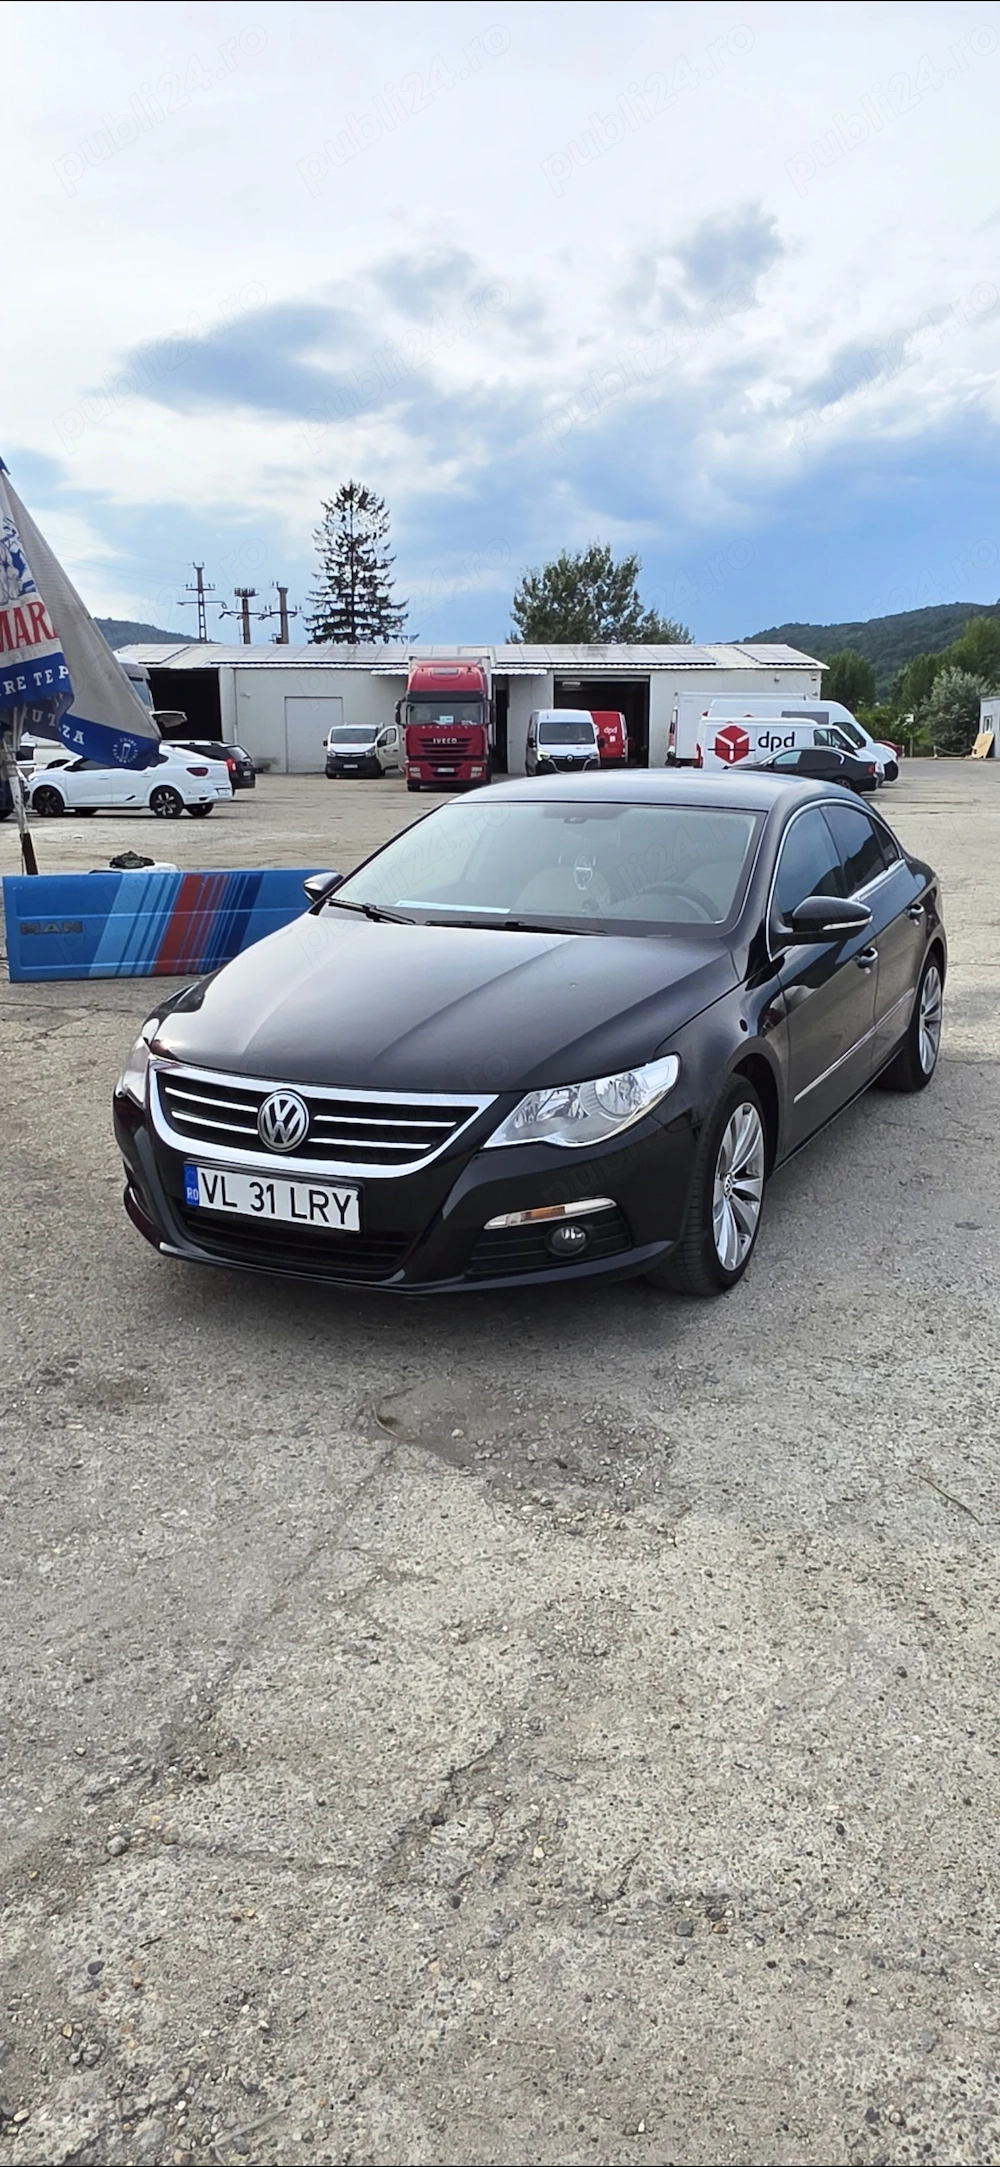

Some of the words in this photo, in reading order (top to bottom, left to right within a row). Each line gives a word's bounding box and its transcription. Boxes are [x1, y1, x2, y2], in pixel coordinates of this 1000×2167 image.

[603, 726, 618, 735] dpd
[758, 731, 795, 752] dpd
[20, 921, 83, 935] MAN
[187, 1187, 199, 1201] RO
[202, 1173, 238, 1208] VL
[249, 1182, 275, 1214] 31
[290, 1187, 352, 1225] LRY
